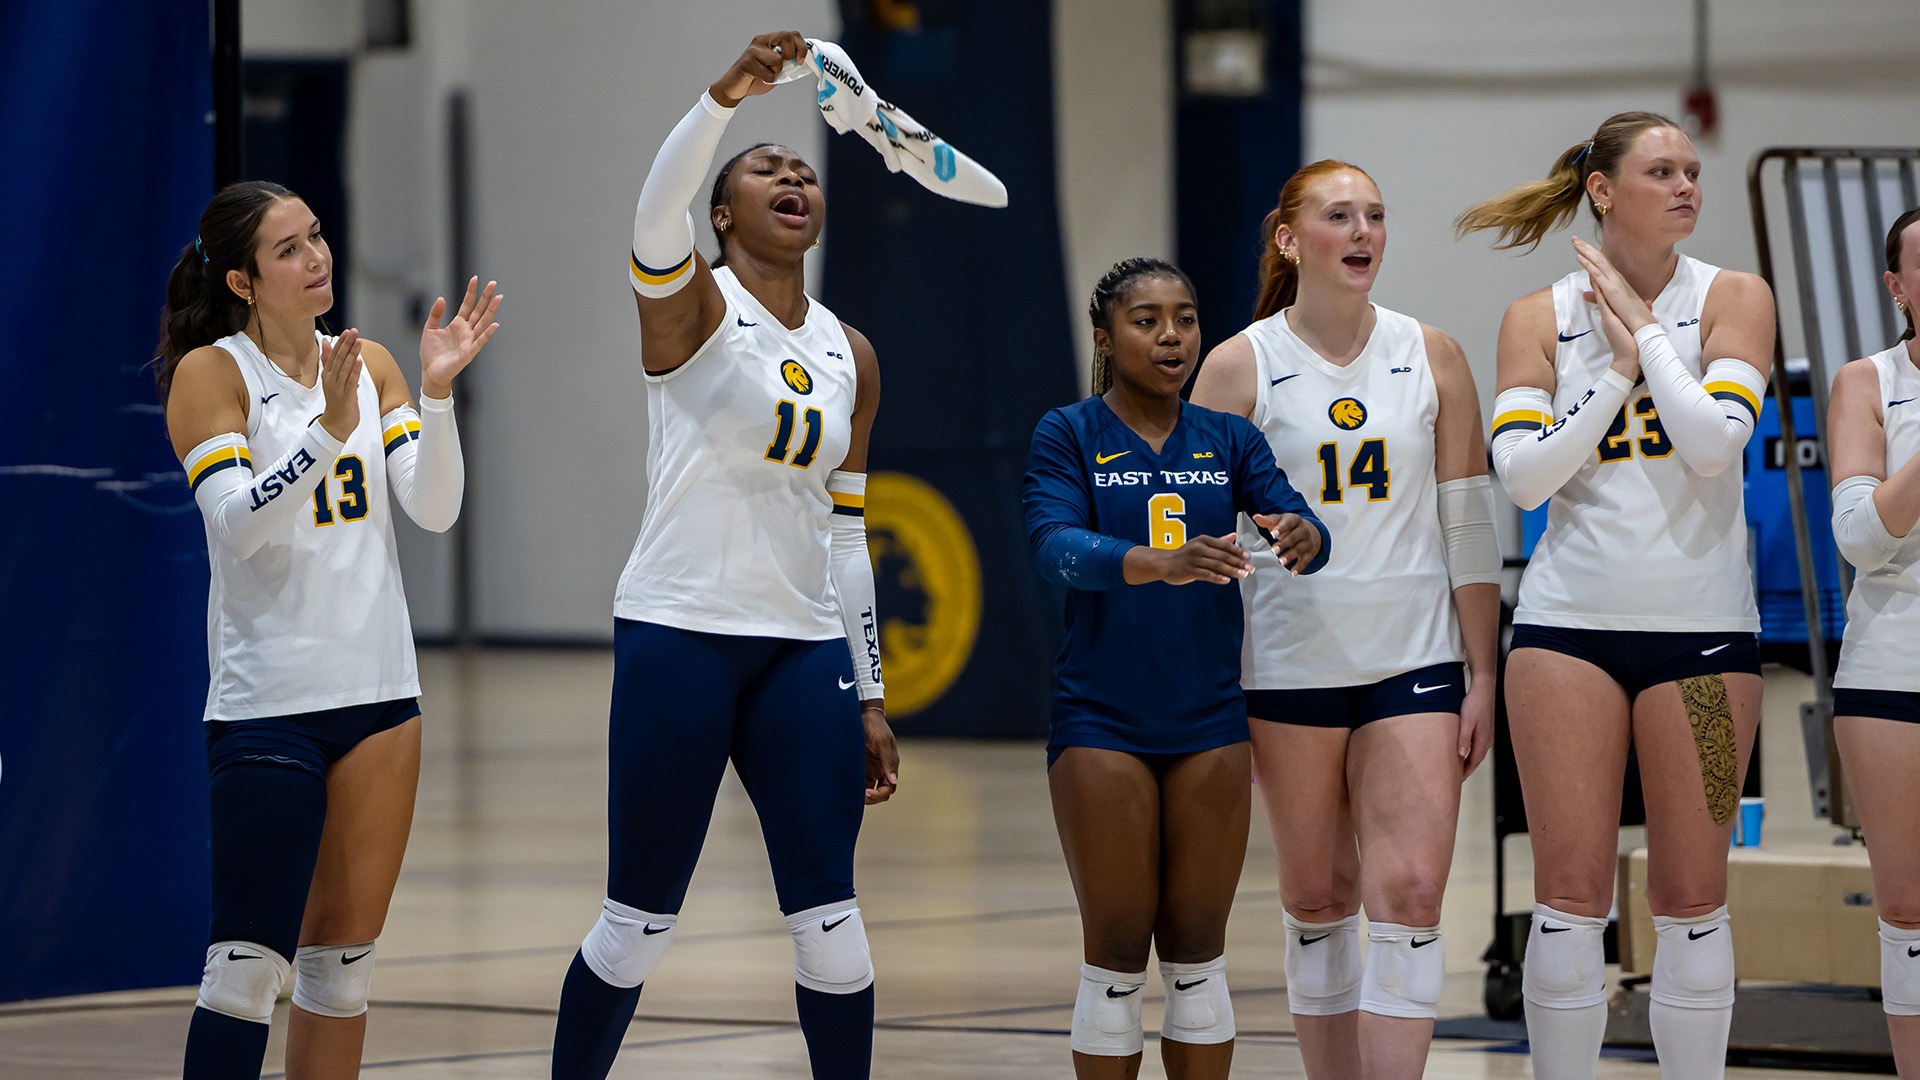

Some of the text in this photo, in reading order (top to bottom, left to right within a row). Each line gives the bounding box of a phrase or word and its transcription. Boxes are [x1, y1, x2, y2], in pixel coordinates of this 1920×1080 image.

[822, 55, 864, 97] POWER
[764, 398, 824, 470] 11
[1596, 394, 1676, 465] 23
[250, 447, 316, 512] EAST
[312, 453, 370, 527] 13
[1094, 470, 1229, 487] EAST TEXAS
[1316, 437, 1391, 504] 14
[1147, 493, 1187, 551] 6
[861, 606, 883, 684] TEXAS
